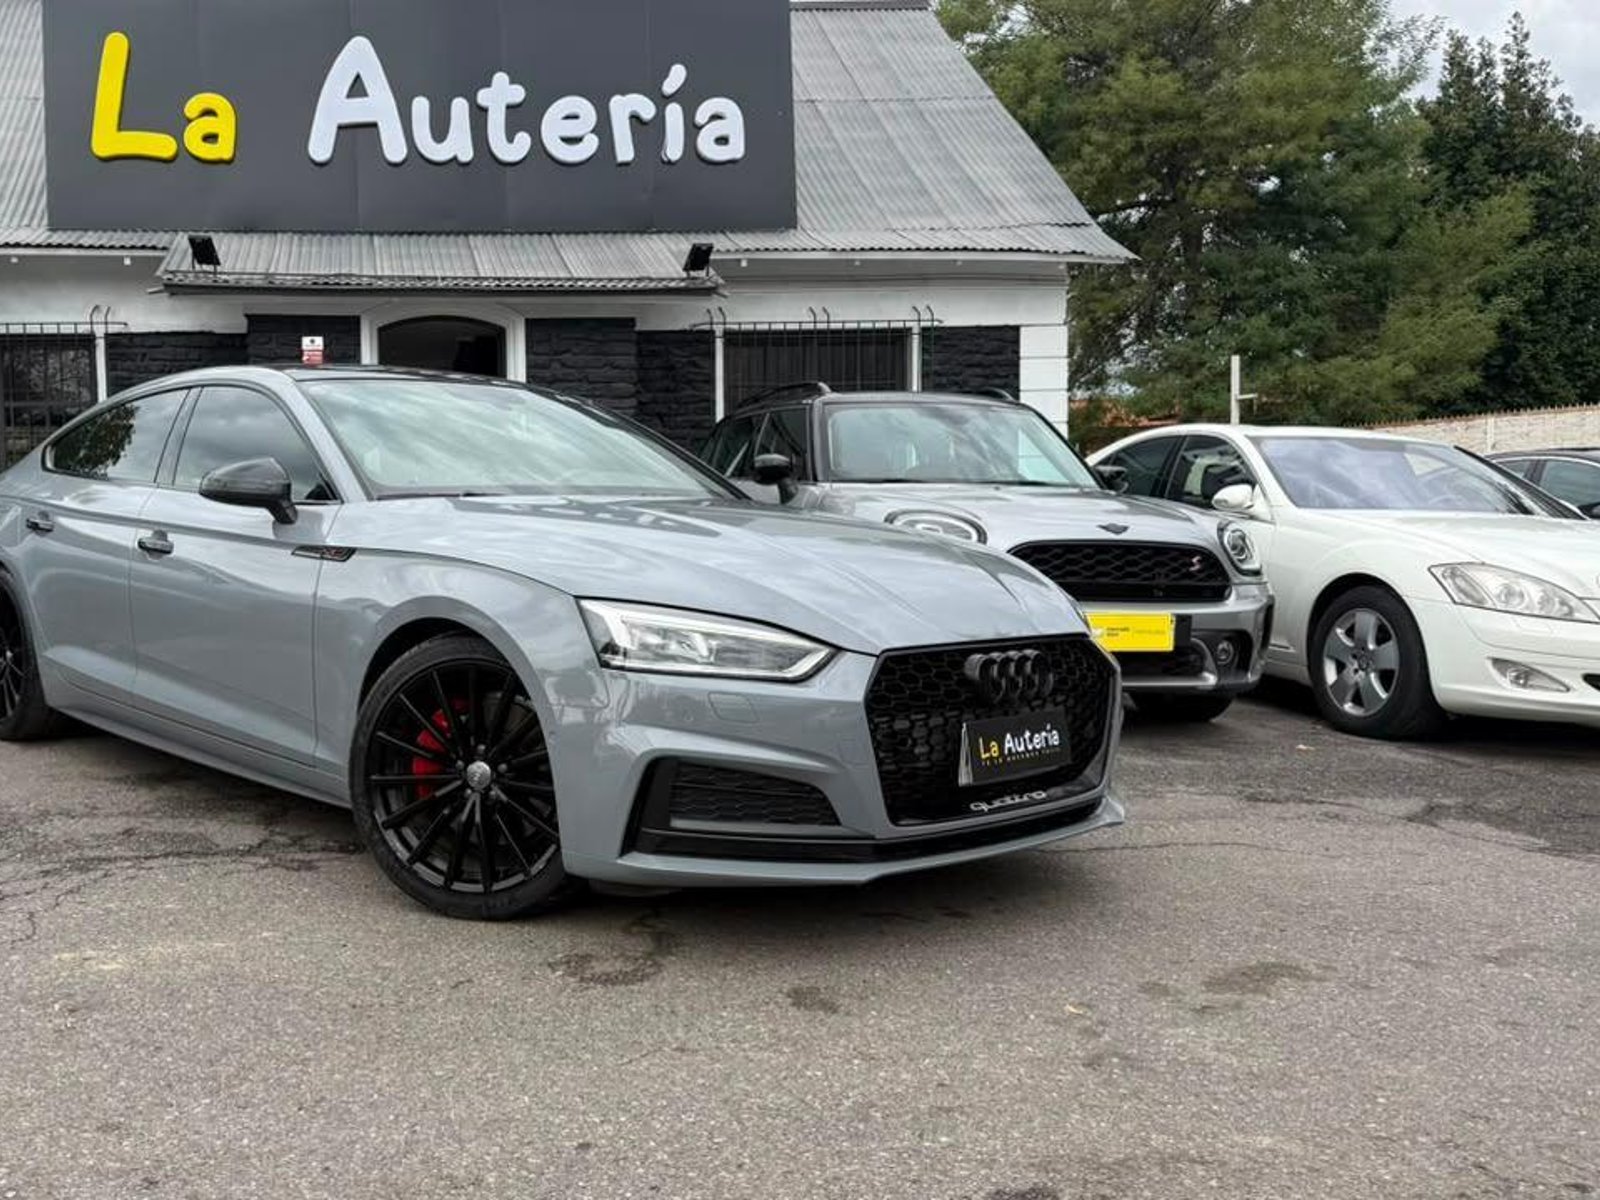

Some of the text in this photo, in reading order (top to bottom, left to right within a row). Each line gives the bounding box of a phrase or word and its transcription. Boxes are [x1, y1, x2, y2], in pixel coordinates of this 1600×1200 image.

[91, 32, 746, 165] La Autería
[1189, 555, 1202, 572] S
[978, 736, 999, 759] La
[1004, 723, 1060, 755] Autería
[970, 790, 1047, 812] quattro
